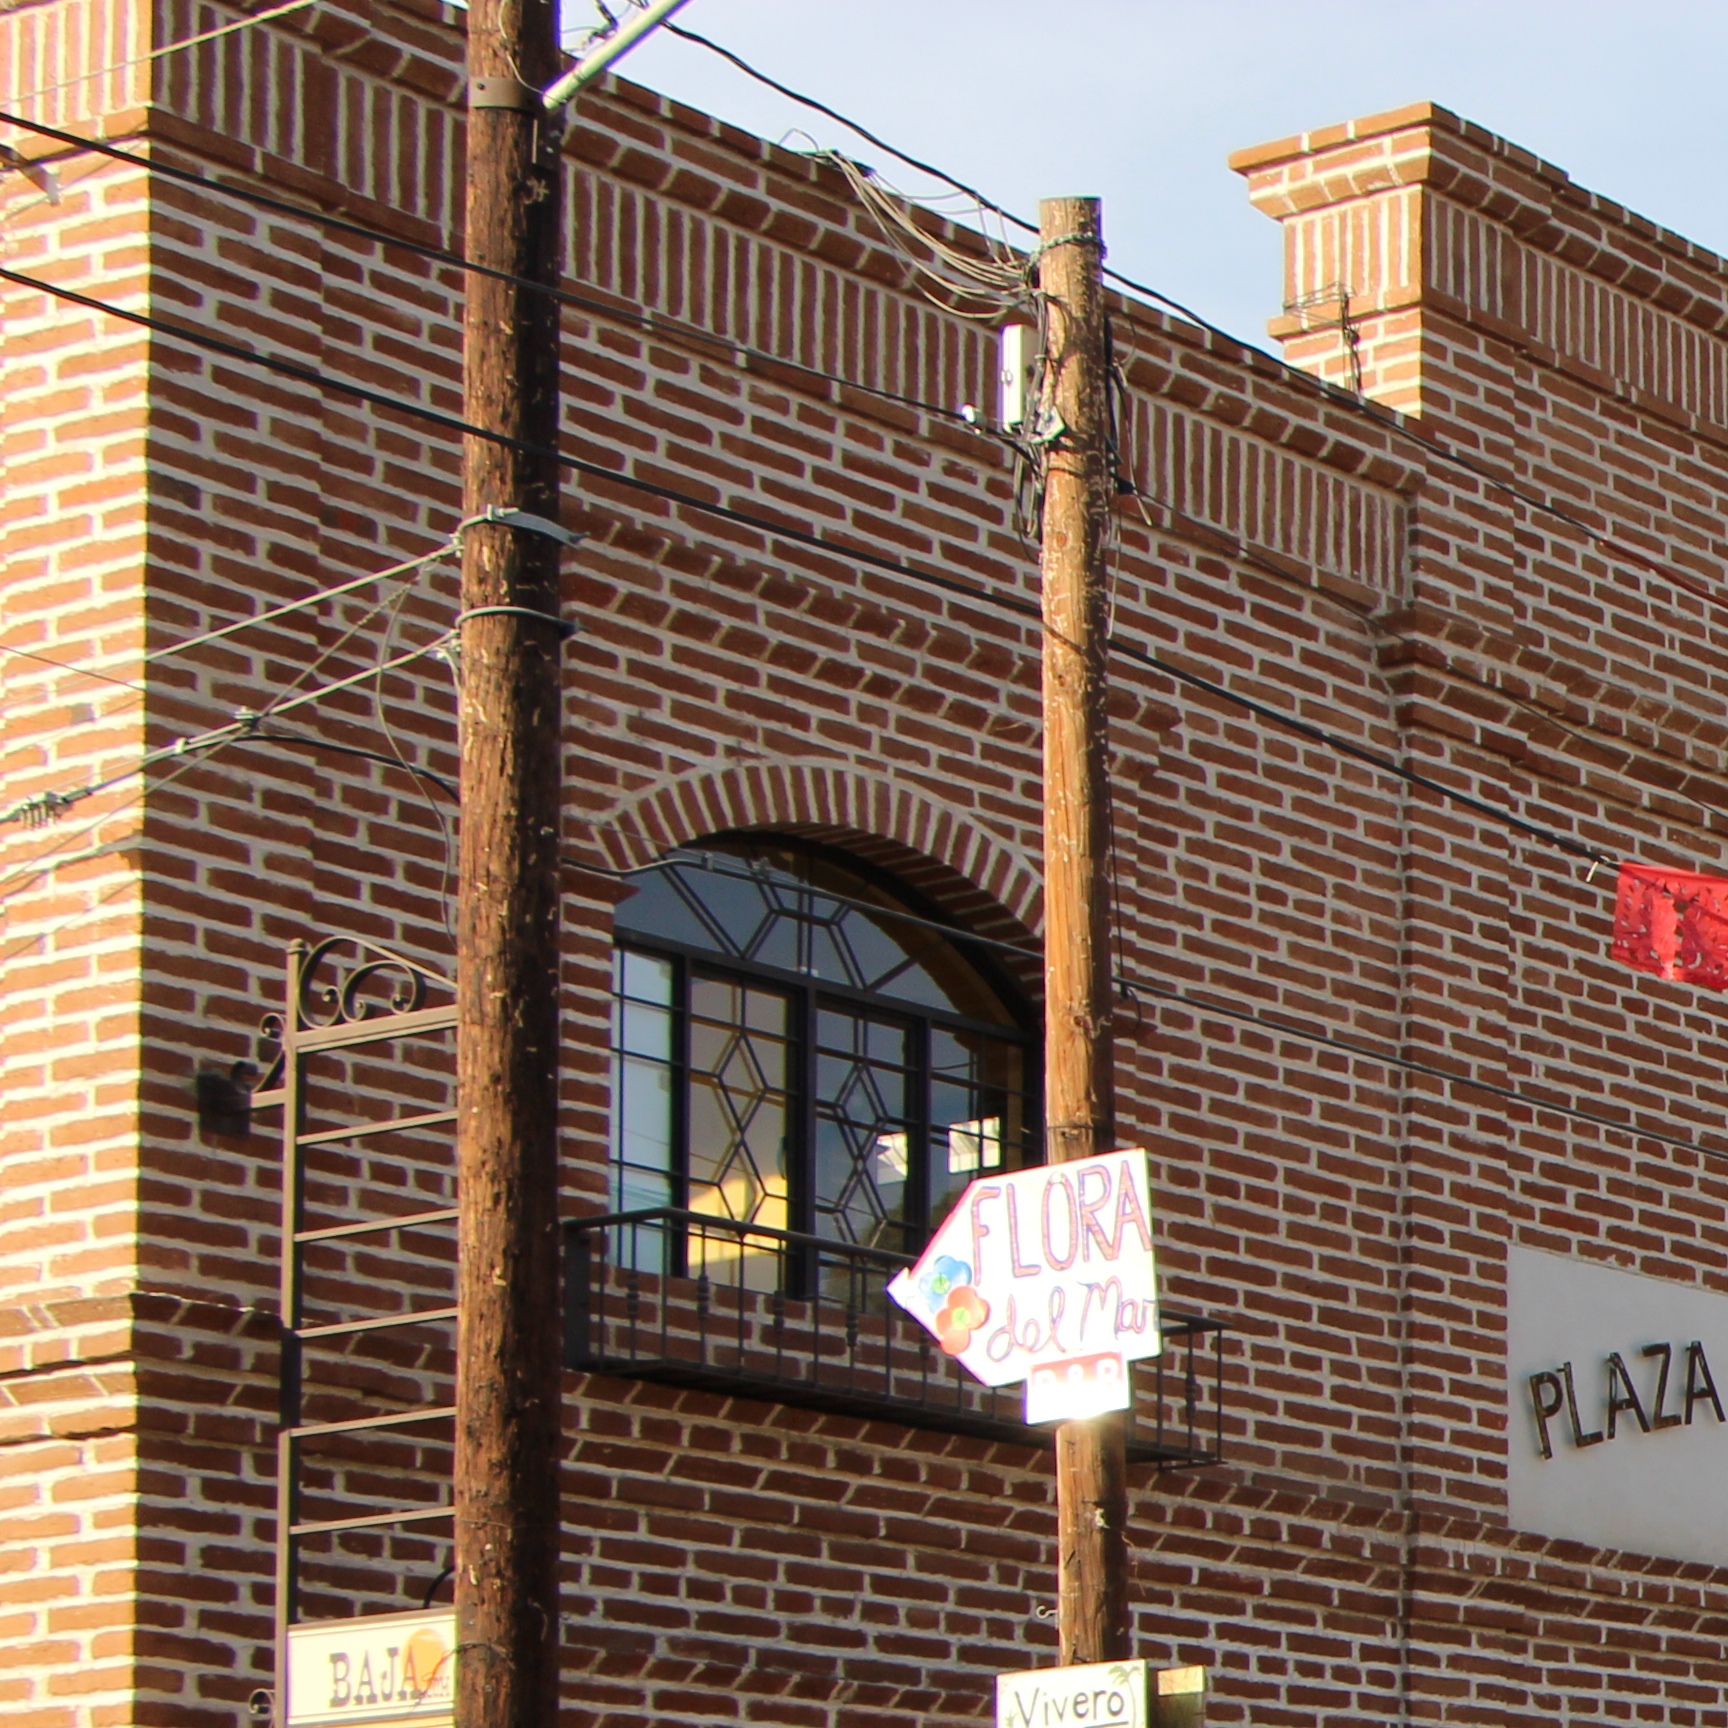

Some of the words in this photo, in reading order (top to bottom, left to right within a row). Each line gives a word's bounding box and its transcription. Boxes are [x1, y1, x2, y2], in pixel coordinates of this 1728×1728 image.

[971, 1160, 1153, 1286] FLORA
[986, 1286, 1067, 1363] del
[1077, 1276, 1160, 1341] Mar
[1528, 1340, 1727, 1461] PLAZA
[329, 1645, 424, 1708] BAJA
[1015, 1687, 1125, 1728] Vivero
